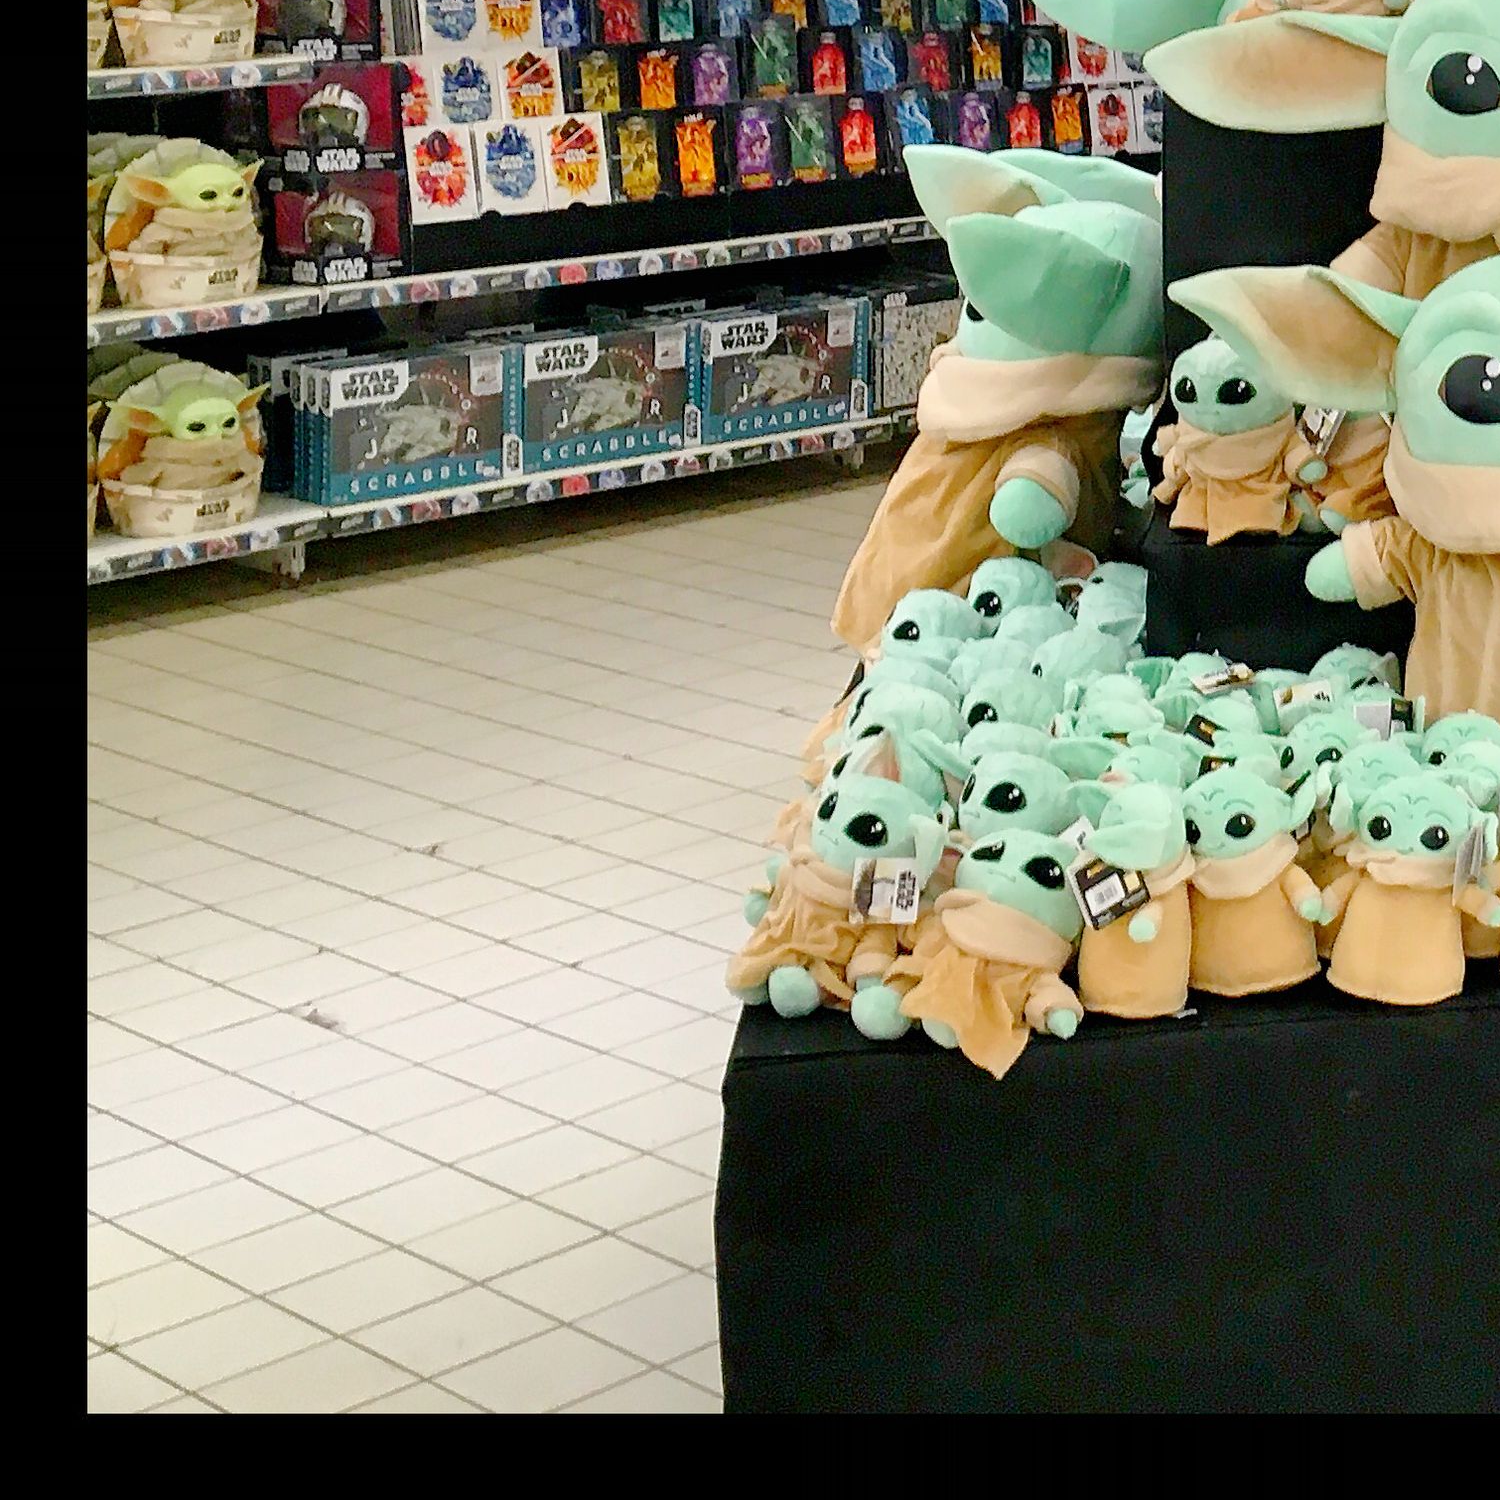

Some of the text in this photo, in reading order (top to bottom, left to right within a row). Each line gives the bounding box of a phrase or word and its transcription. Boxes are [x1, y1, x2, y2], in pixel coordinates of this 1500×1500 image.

[726, 321, 769, 338] STAR
[542, 343, 589, 361] STAR
[721, 335, 767, 351] WARS
[535, 356, 587, 373] WARS
[349, 368, 399, 388] STAR
[342, 382, 396, 401] WARS
[724, 403, 836, 434] SCRABBLE
[542, 429, 667, 462] SCRABBLE
[350, 459, 485, 495] SCRABBLE
